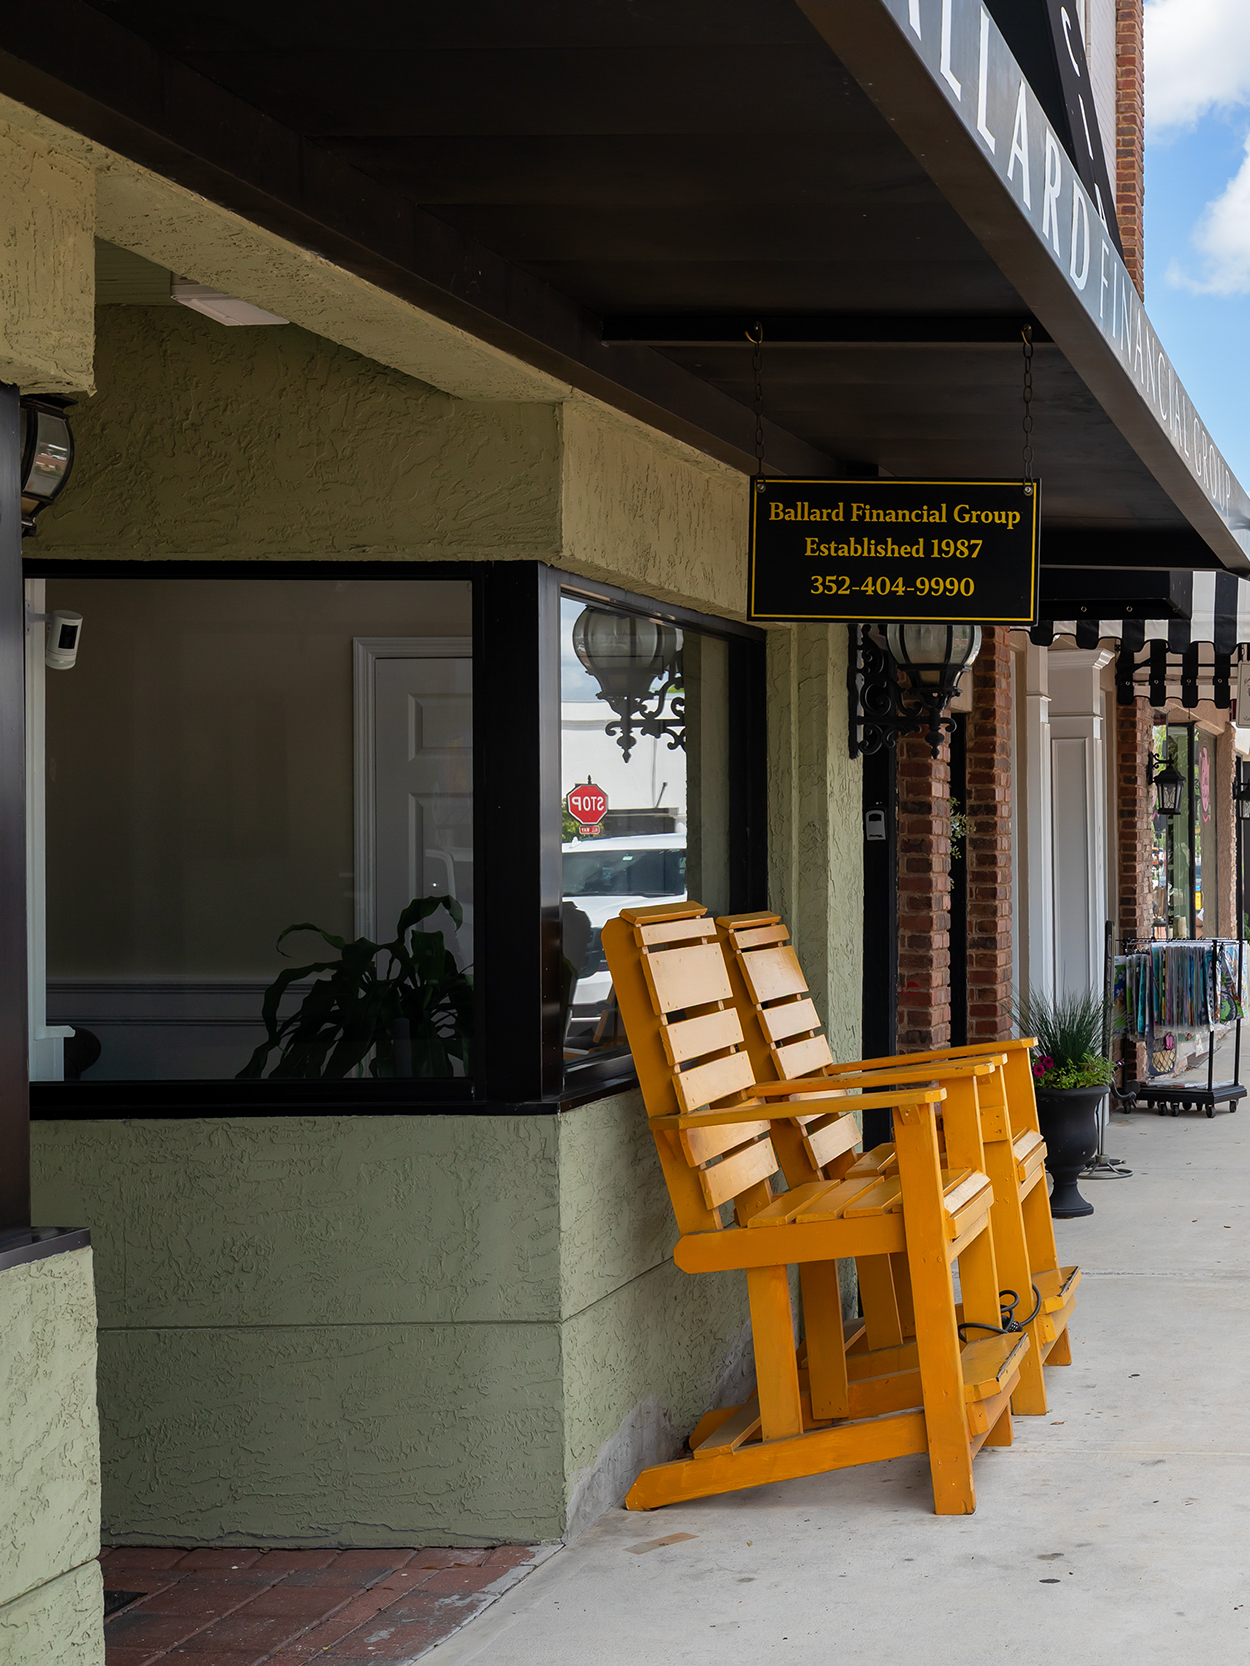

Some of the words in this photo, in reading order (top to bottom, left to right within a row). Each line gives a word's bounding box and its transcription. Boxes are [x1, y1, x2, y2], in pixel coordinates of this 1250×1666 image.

[1100, 238, 1190, 458] FINANCIAL
[1193, 417, 1231, 518] GROUP
[768, 502, 845, 522] Ballard
[850, 503, 947, 523] Financial
[953, 505, 1021, 530] Group
[804, 537, 925, 558] Established
[931, 539, 983, 559] 1987
[810, 575, 975, 597] 352-404-9990
